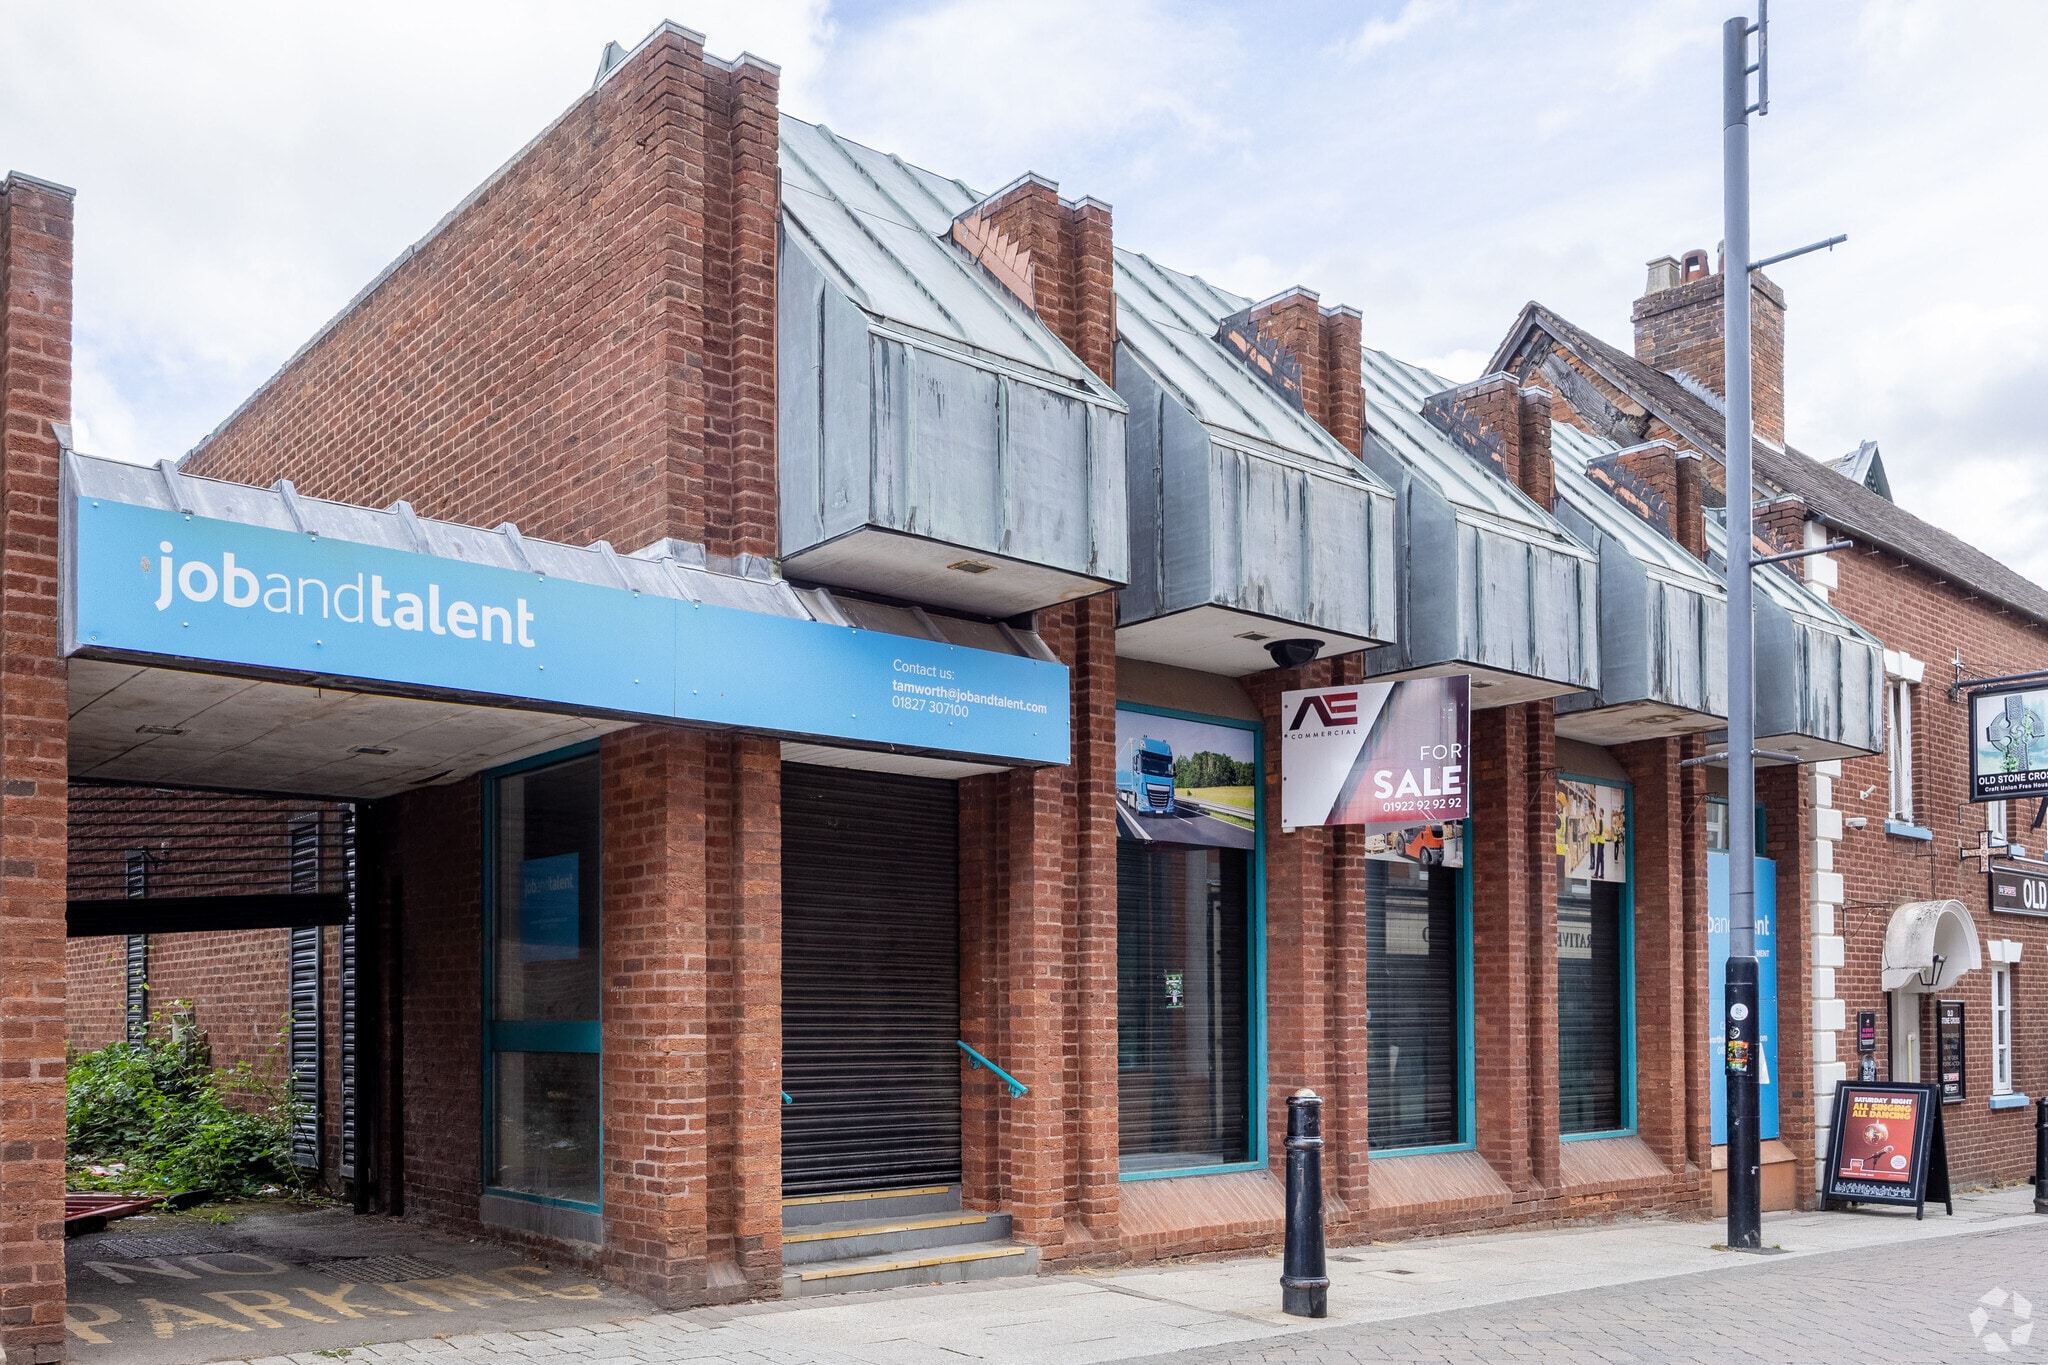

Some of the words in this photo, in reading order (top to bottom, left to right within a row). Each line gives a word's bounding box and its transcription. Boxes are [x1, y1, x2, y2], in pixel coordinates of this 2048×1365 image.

[155, 540, 536, 648] jobandtalent
[893, 658, 937, 678] Contact
[939, 668, 955, 680] us:
[892, 679, 1047, 714] tamworth@jobandtalent.com
[892, 695, 926, 712] 01827
[929, 700, 969, 718] 307100
[1291, 729, 1357, 740] COMMERCIAL
[1420, 743, 1462, 761] FOR
[1373, 765, 1462, 799] SALE
[1979, 776, 1996, 786] OLD
[1998, 773, 2026, 784] STONE
[2028, 771, 2048, 781] CRO
[1383, 800, 1414, 812] 01922
[1417, 800, 1430, 810] 92
[1432, 799, 1446, 809] 92
[1448, 797, 1461, 808] 92
[2023, 879, 2047, 909] OLD
[1853, 1103, 1869, 1111] ALL
[1871, 1103, 1912, 1113] SINGING
[1854, 1096, 1888, 1104] SATURDAY
[1852, 1110, 1868, 1118] ALL
[1869, 1110, 1911, 1120] DANCING
[84, 1252, 290, 1284] NO
[65, 1266, 602, 1344] PARKING
